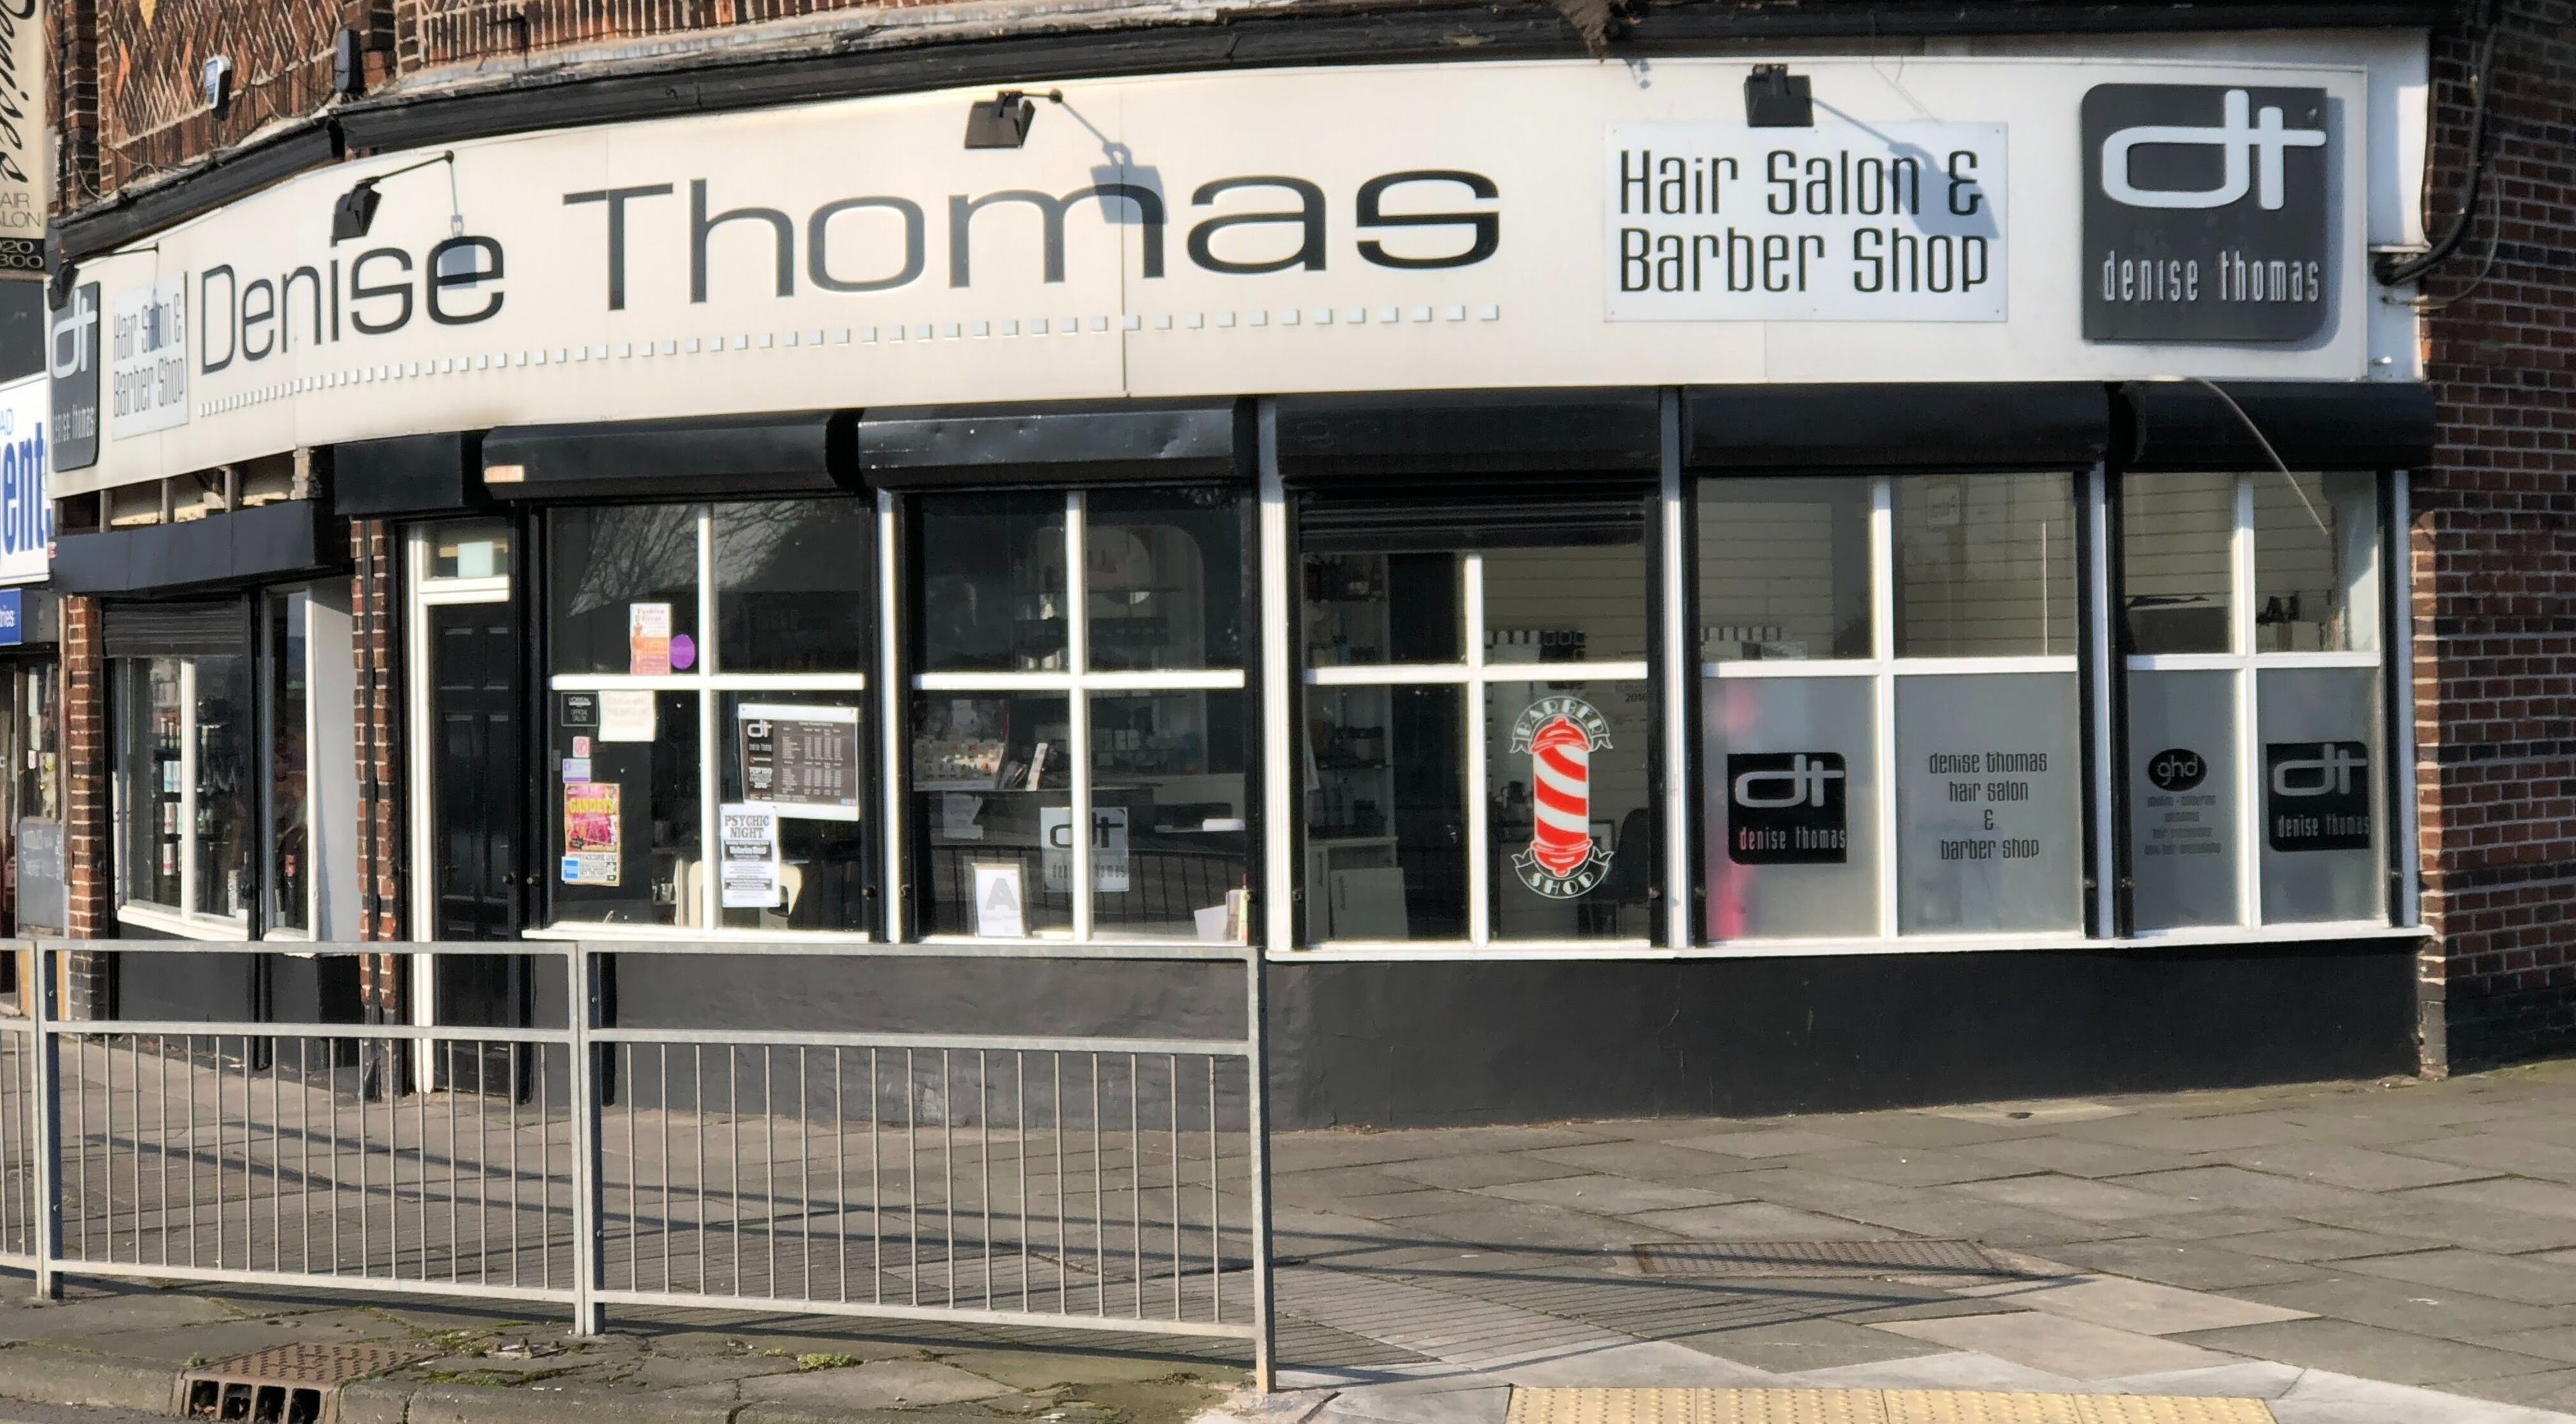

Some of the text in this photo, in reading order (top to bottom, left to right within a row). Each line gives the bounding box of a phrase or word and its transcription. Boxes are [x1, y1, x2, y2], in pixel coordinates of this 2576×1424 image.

[2102, 89, 2326, 210] dt
[1619, 149, 1984, 215] Hair Salon &
[0, 211, 41, 227] LON
[0, 240, 34, 254] 20
[1620, 226, 1988, 292] Barber Shop
[201, 169, 1500, 376] Denise Thomas
[2103, 249, 2319, 302] denise thomas
[114, 313, 136, 362] Hair
[142, 303, 171, 353] Salon
[114, 356, 184, 418] Barber Shop
[1516, 699, 1605, 737] BARBER
[1929, 752, 2047, 773] denise thomas
[2157, 754, 2199, 786] ghd
[1735, 754, 1845, 808] dt
[1949, 780, 2029, 802] hair salon
[724, 814, 770, 827] PSYCHIC
[730, 827, 765, 839] NIGHT
[2277, 813, 2371, 838] denise thomas
[1739, 825, 1846, 851] denise thomas
[1941, 838, 2040, 861] barber shop
[1528, 871, 1594, 895] SHOP
